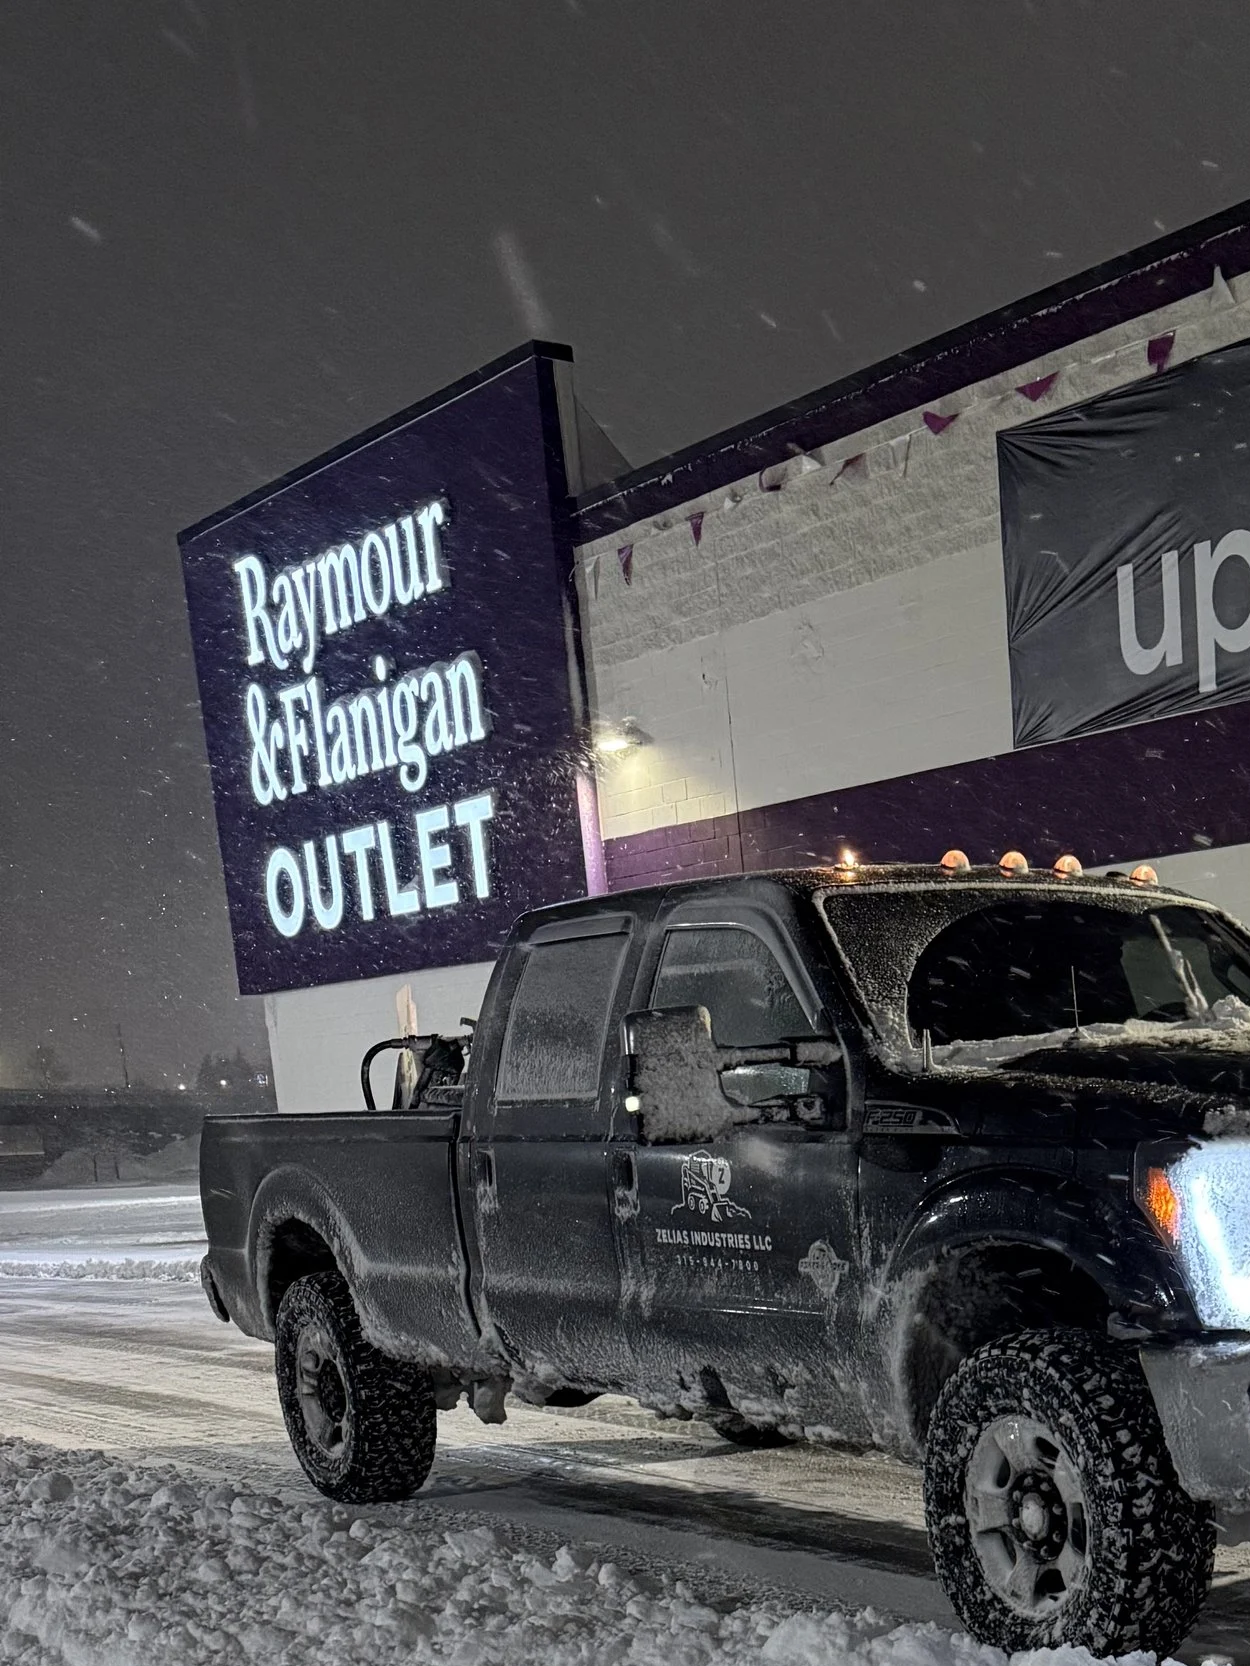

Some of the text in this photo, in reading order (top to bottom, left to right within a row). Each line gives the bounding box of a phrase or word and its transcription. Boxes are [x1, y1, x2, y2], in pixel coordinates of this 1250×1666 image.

[233, 498, 446, 673] Raymour
[265, 795, 493, 938] OUTLET
[655, 1228, 773, 1251] ZELIAS INDUSTRIES LLC
